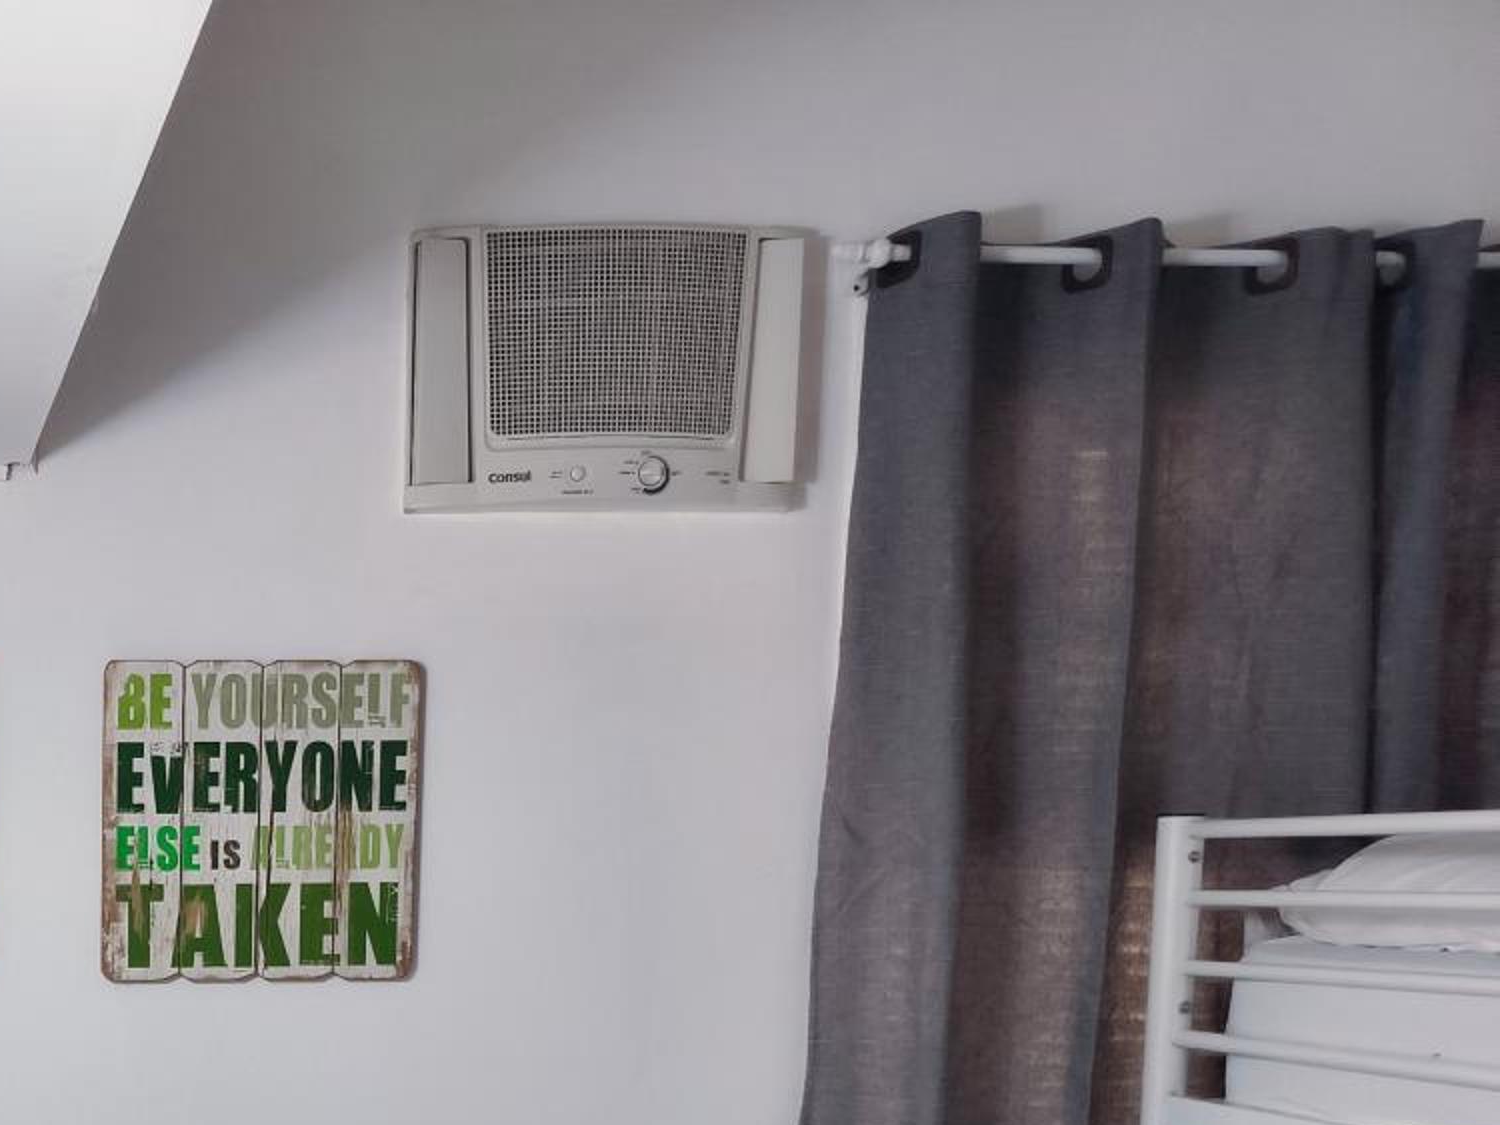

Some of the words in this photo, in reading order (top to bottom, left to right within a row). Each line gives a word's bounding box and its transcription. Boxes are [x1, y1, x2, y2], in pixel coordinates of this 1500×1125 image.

[117, 673, 173, 731] BE
[191, 672, 411, 730] YOURSELF
[116, 740, 408, 814] EVERYONE
[115, 825, 201, 871] ELSE
[210, 839, 241, 870] IS
[115, 882, 399, 968] TAKEN
